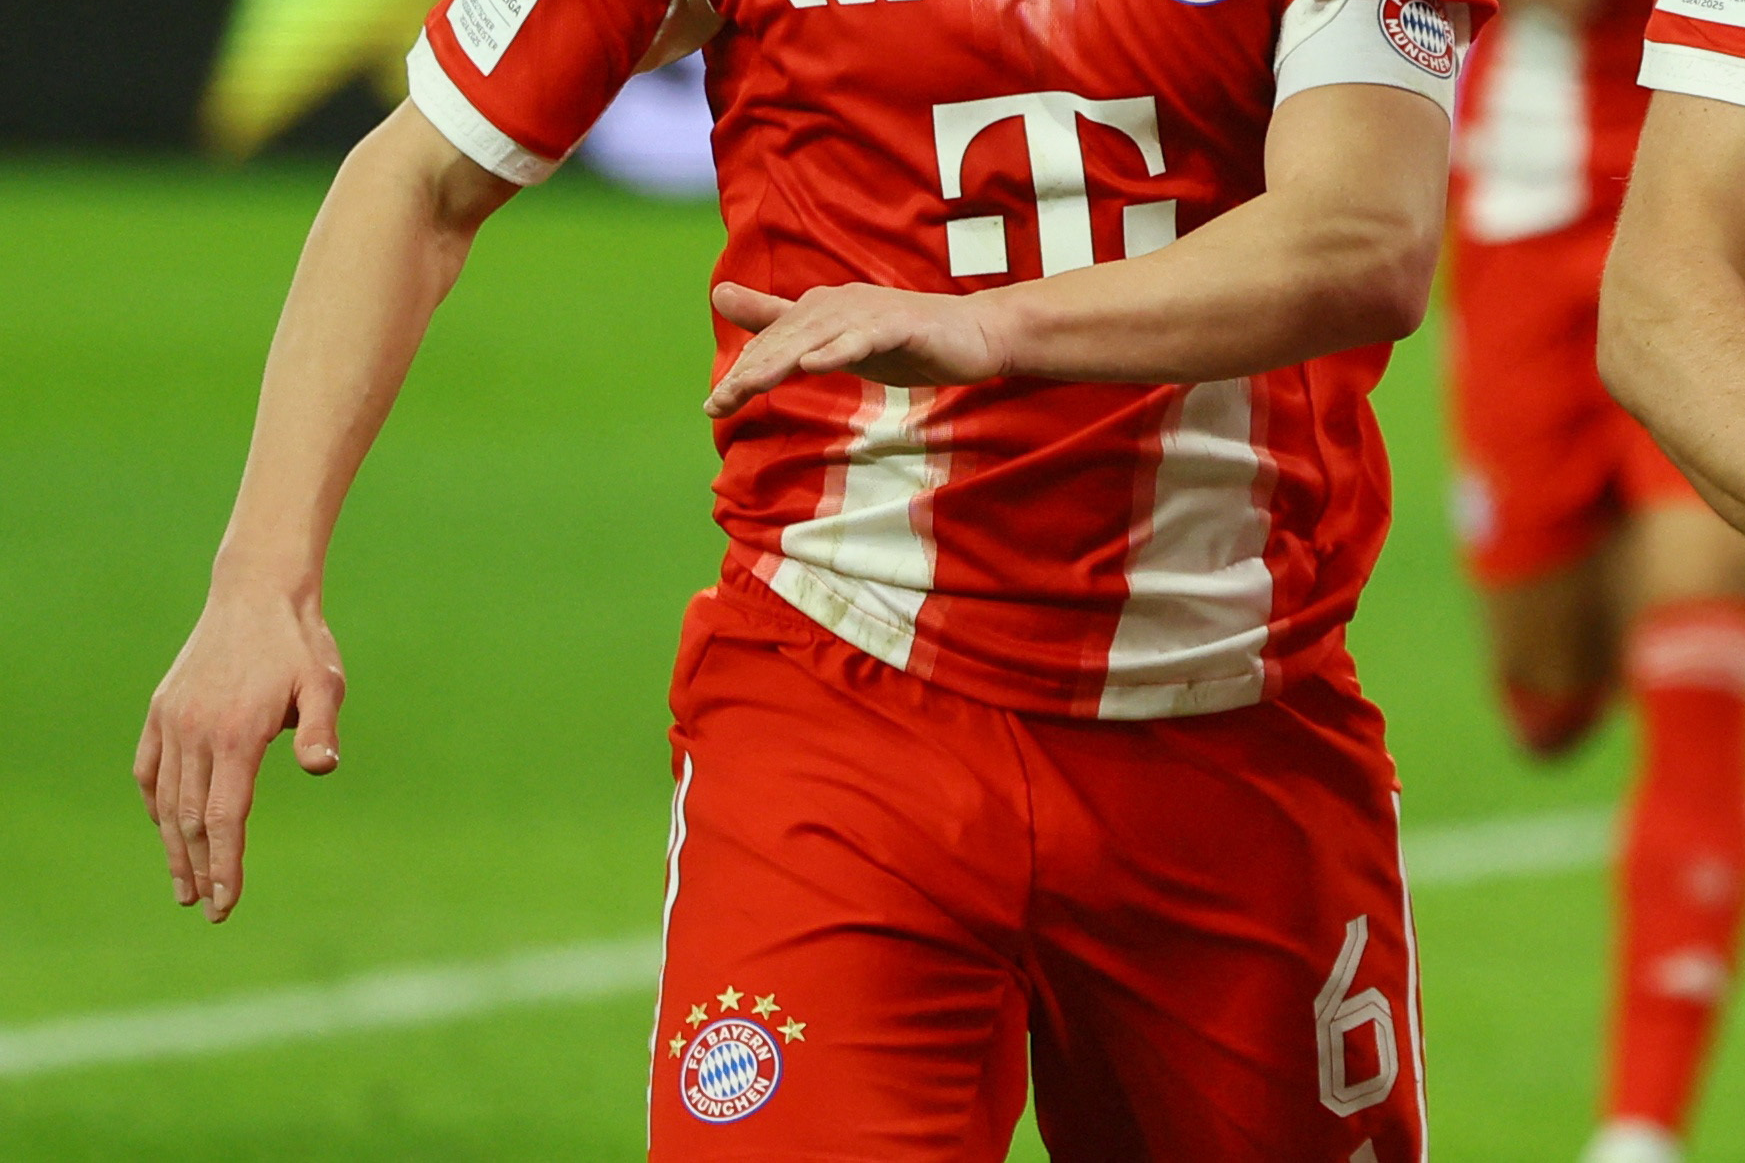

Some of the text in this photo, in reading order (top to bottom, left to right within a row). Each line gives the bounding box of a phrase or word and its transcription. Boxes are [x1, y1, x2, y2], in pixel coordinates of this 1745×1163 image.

[1386, 18, 1451, 72] MÜNCHEN
[1314, 913, 1399, 1118] 6
[688, 1025, 772, 1071] FC BAYERN
